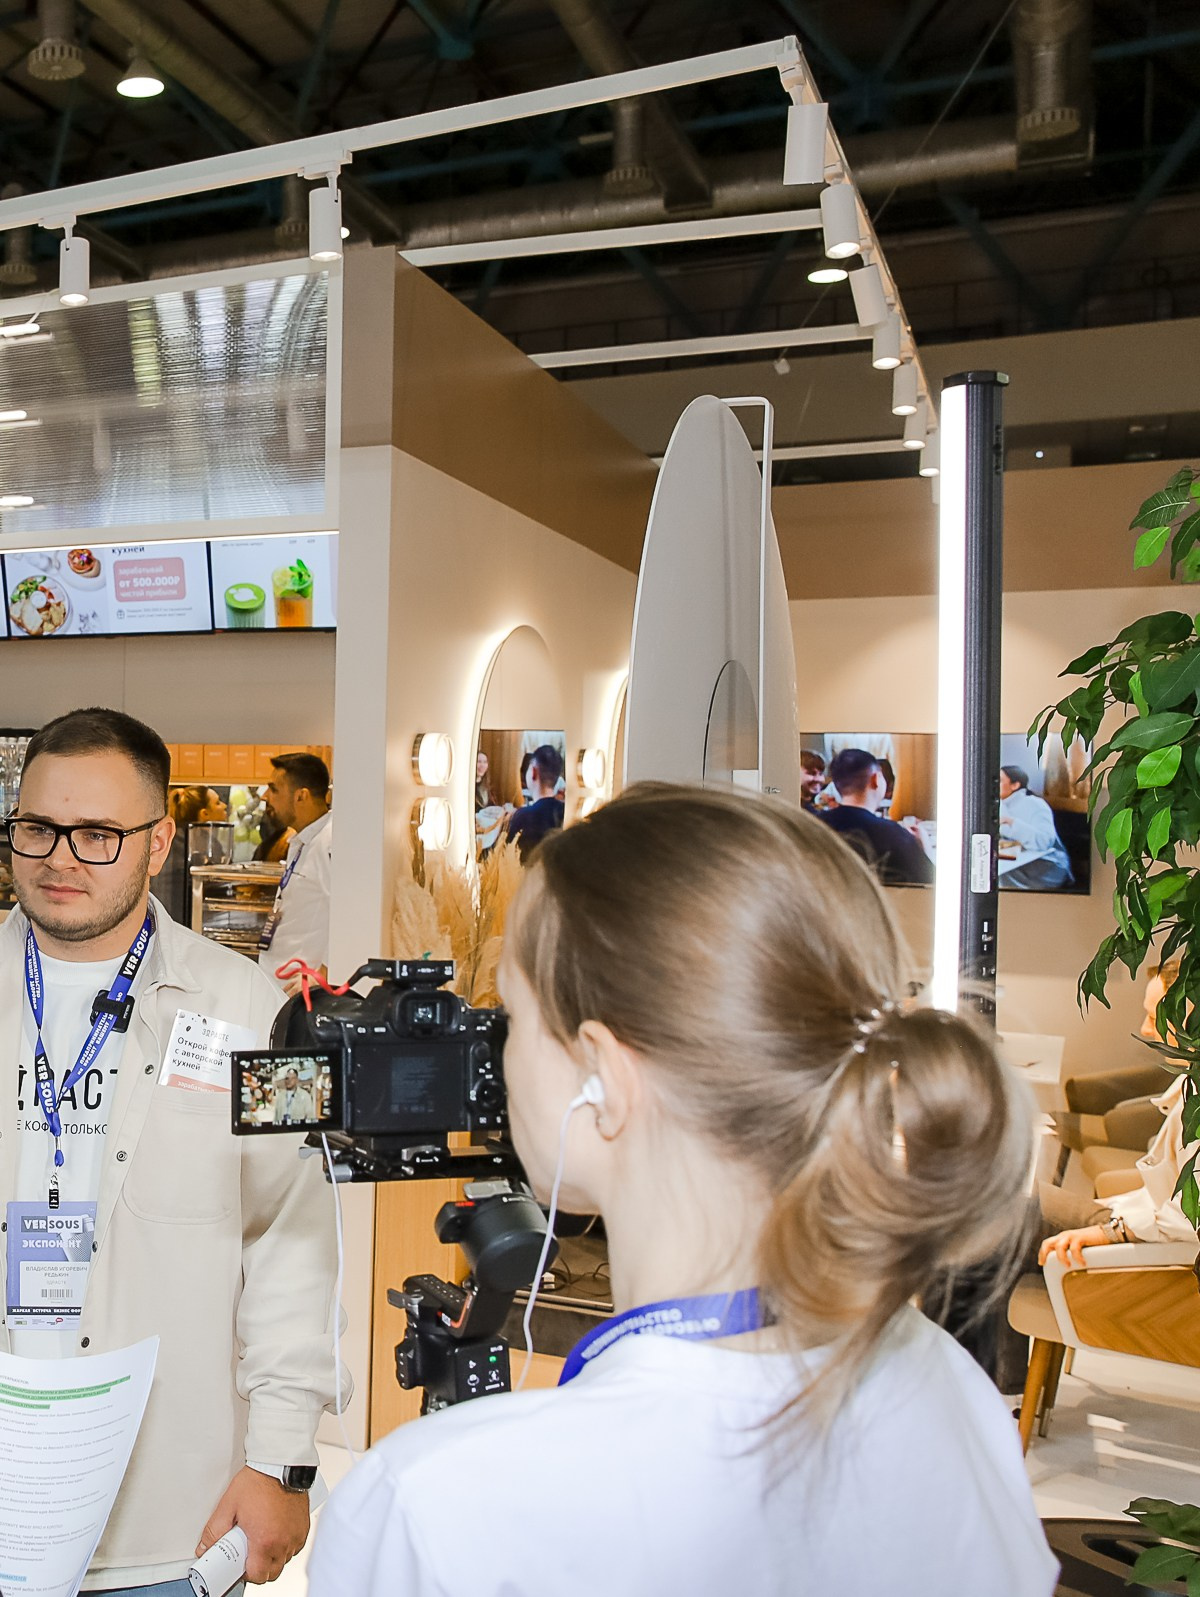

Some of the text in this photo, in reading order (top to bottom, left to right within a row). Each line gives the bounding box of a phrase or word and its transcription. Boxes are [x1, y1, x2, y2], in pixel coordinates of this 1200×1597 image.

[119, 580, 131, 588] от
[122, 928, 149, 976] VERSOUS
[177, 1036, 208, 1051] Открой
[172, 1058, 201, 1071] кухней
[181, 1049, 223, 1067] авторской
[37, 1056, 55, 1115] VERSOUS
[25, 1120, 50, 1132] КОФ
[23, 1219, 80, 1230] VERSOUS
[22, 1239, 82, 1249] ЭКСПОНЕНТ
